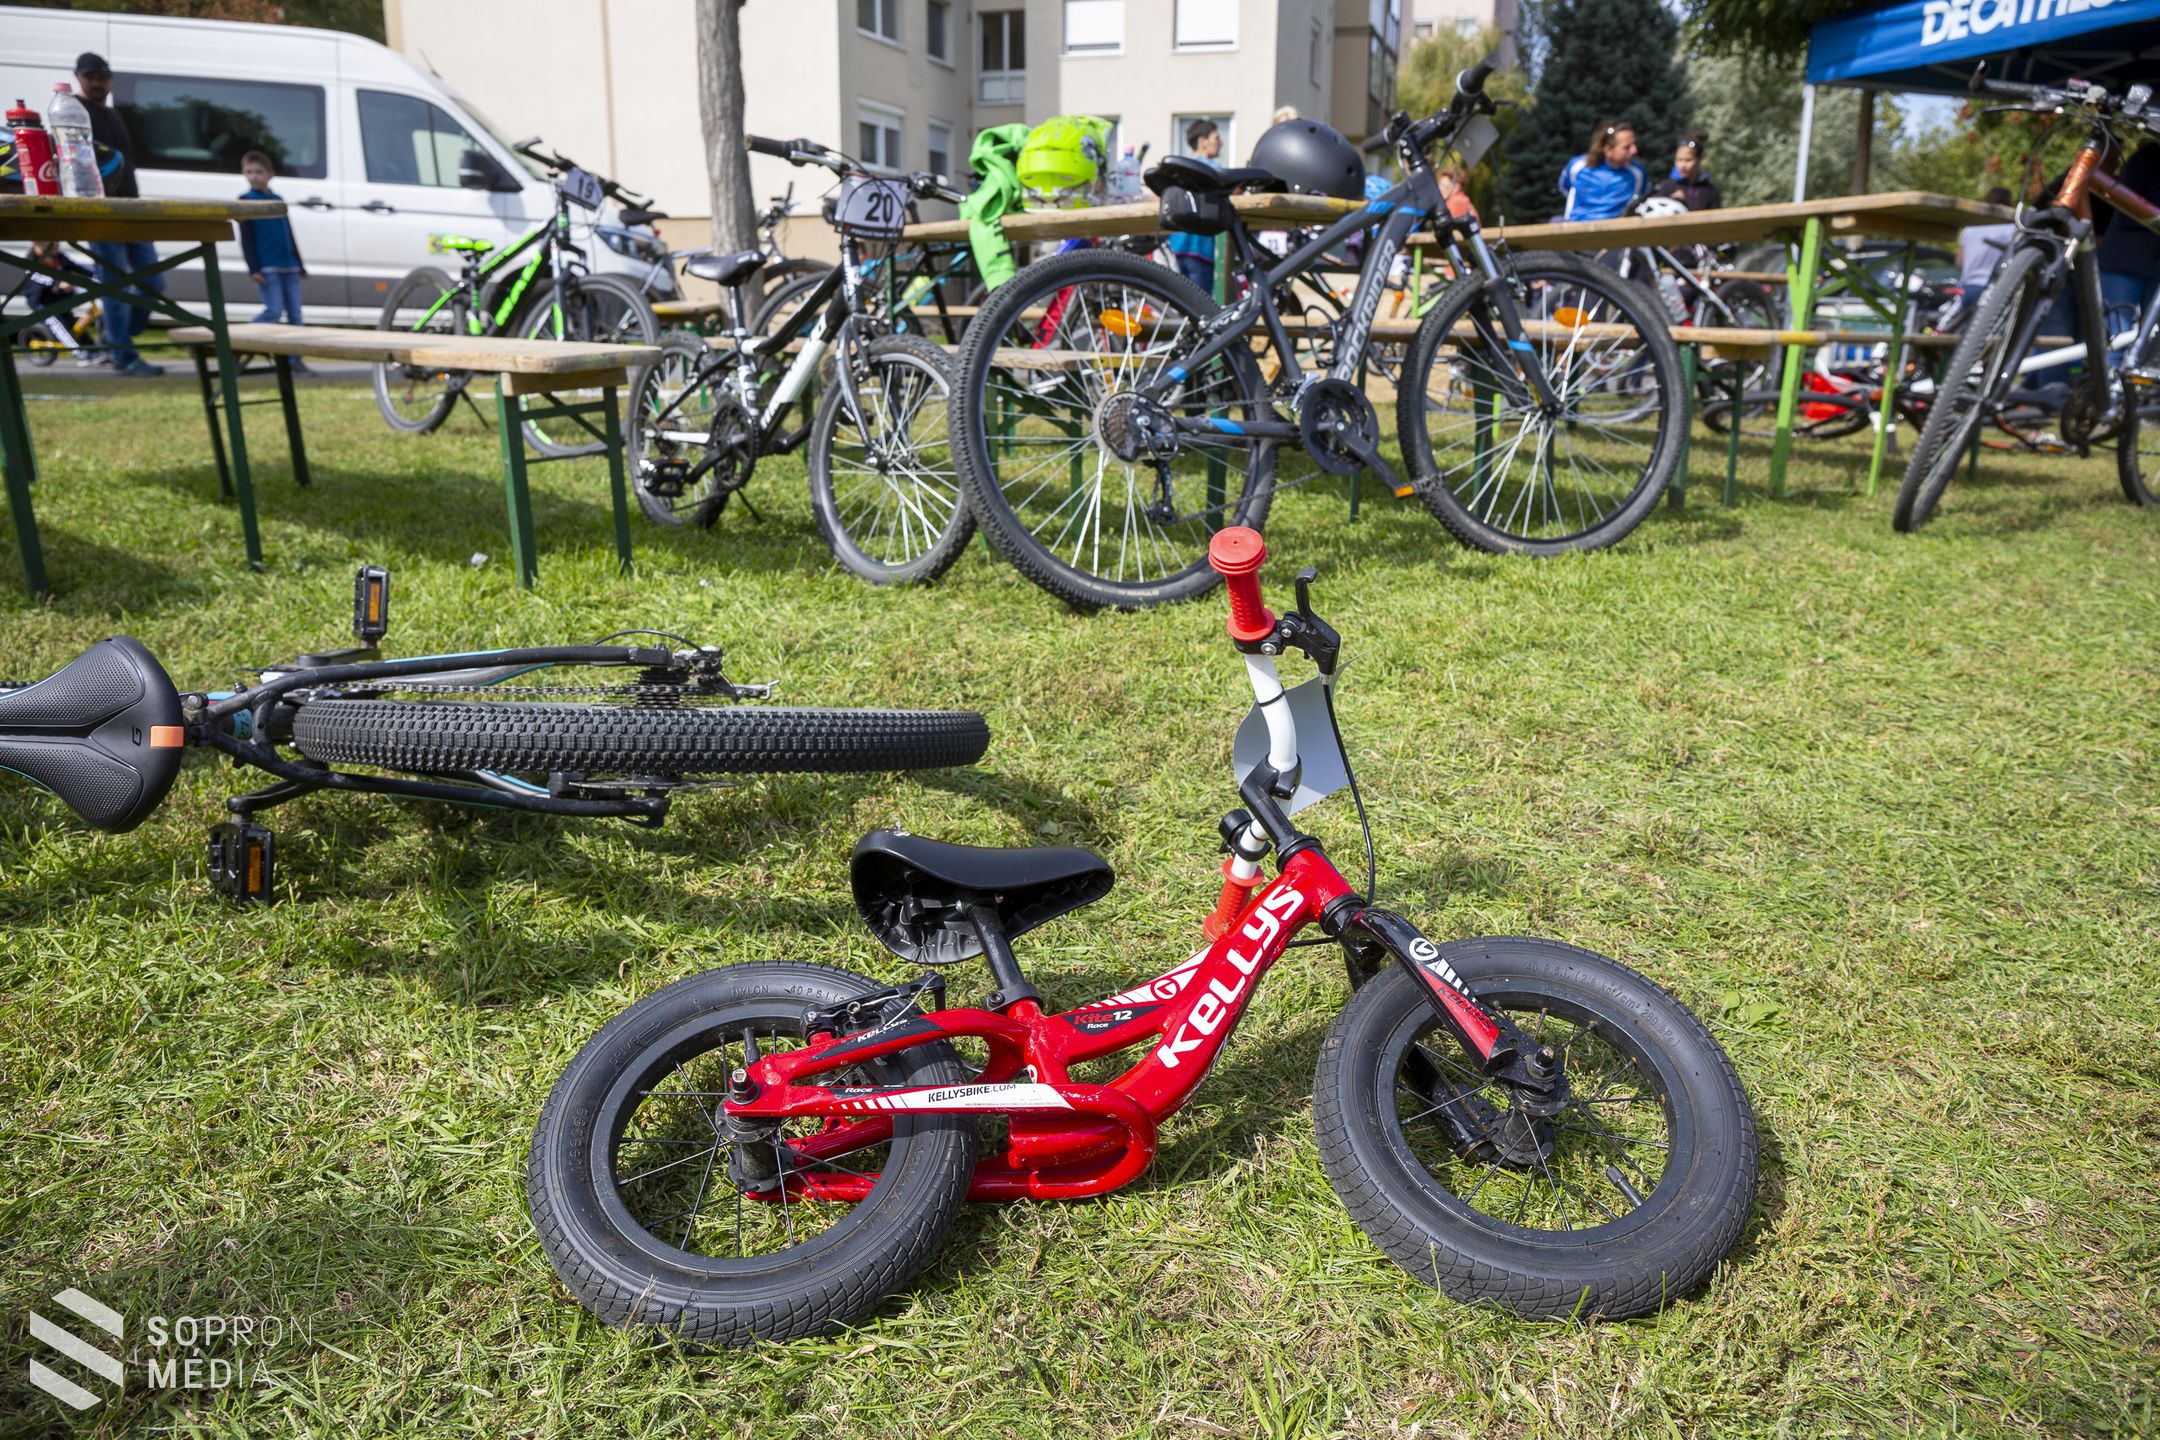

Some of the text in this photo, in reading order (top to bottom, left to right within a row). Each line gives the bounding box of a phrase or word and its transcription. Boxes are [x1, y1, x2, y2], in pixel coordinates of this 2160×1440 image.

[865, 192, 893, 223] 20
[1339, 238, 1397, 381] ROCKRIDER
[731, 985, 769, 998] NYLON
[1086, 1022, 1109, 1030] Race
[928, 1083, 1017, 1103] KELLYSBIKE.COM
